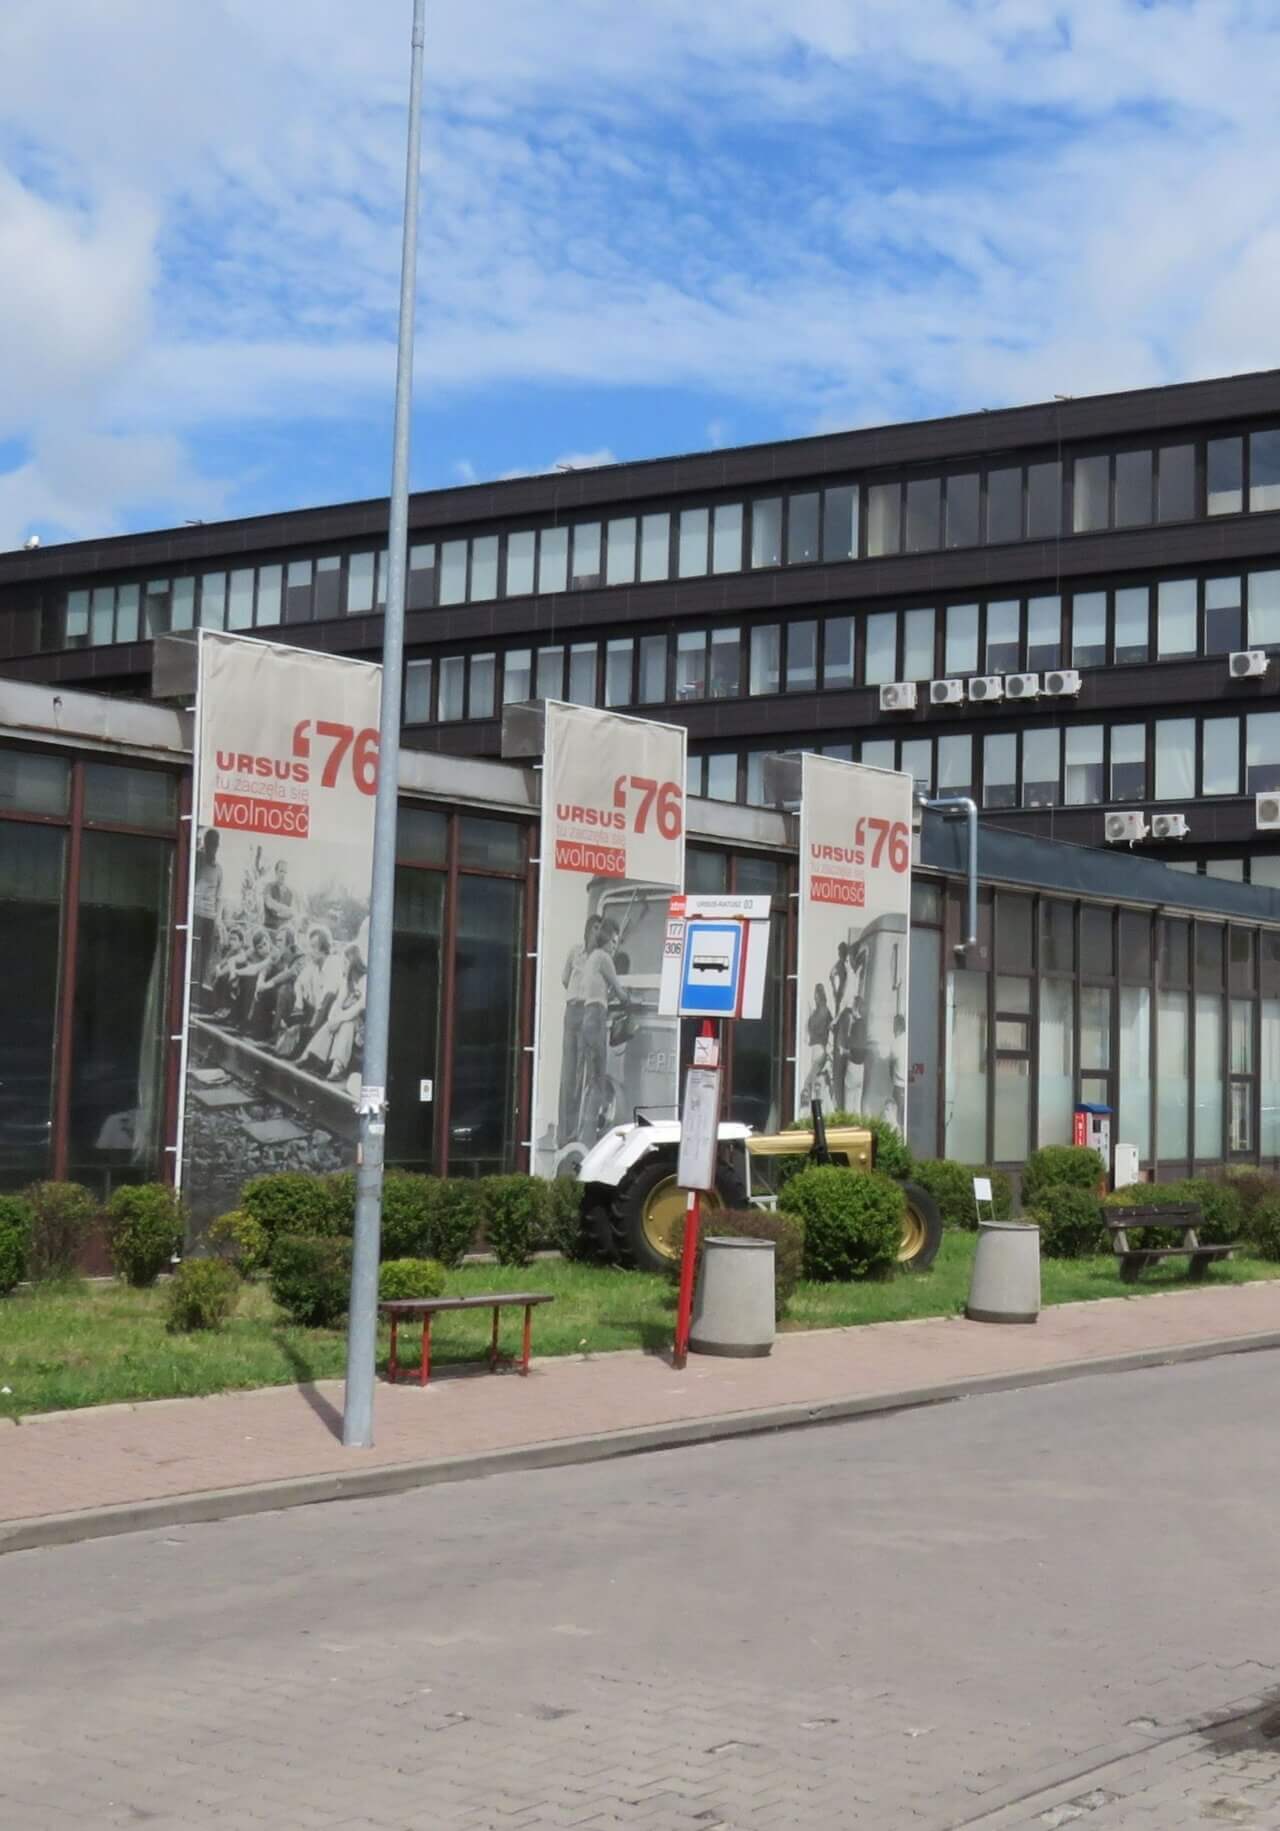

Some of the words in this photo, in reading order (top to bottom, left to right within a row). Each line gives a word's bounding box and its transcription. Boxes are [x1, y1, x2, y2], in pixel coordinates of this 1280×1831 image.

[216, 751, 310, 783] URSUS
[215, 800, 309, 833] wolność
[556, 803, 626, 830] URSUS
[556, 845, 625, 873] wolność
[811, 843, 865, 865] URSUS
[811, 879, 865, 903] wolność
